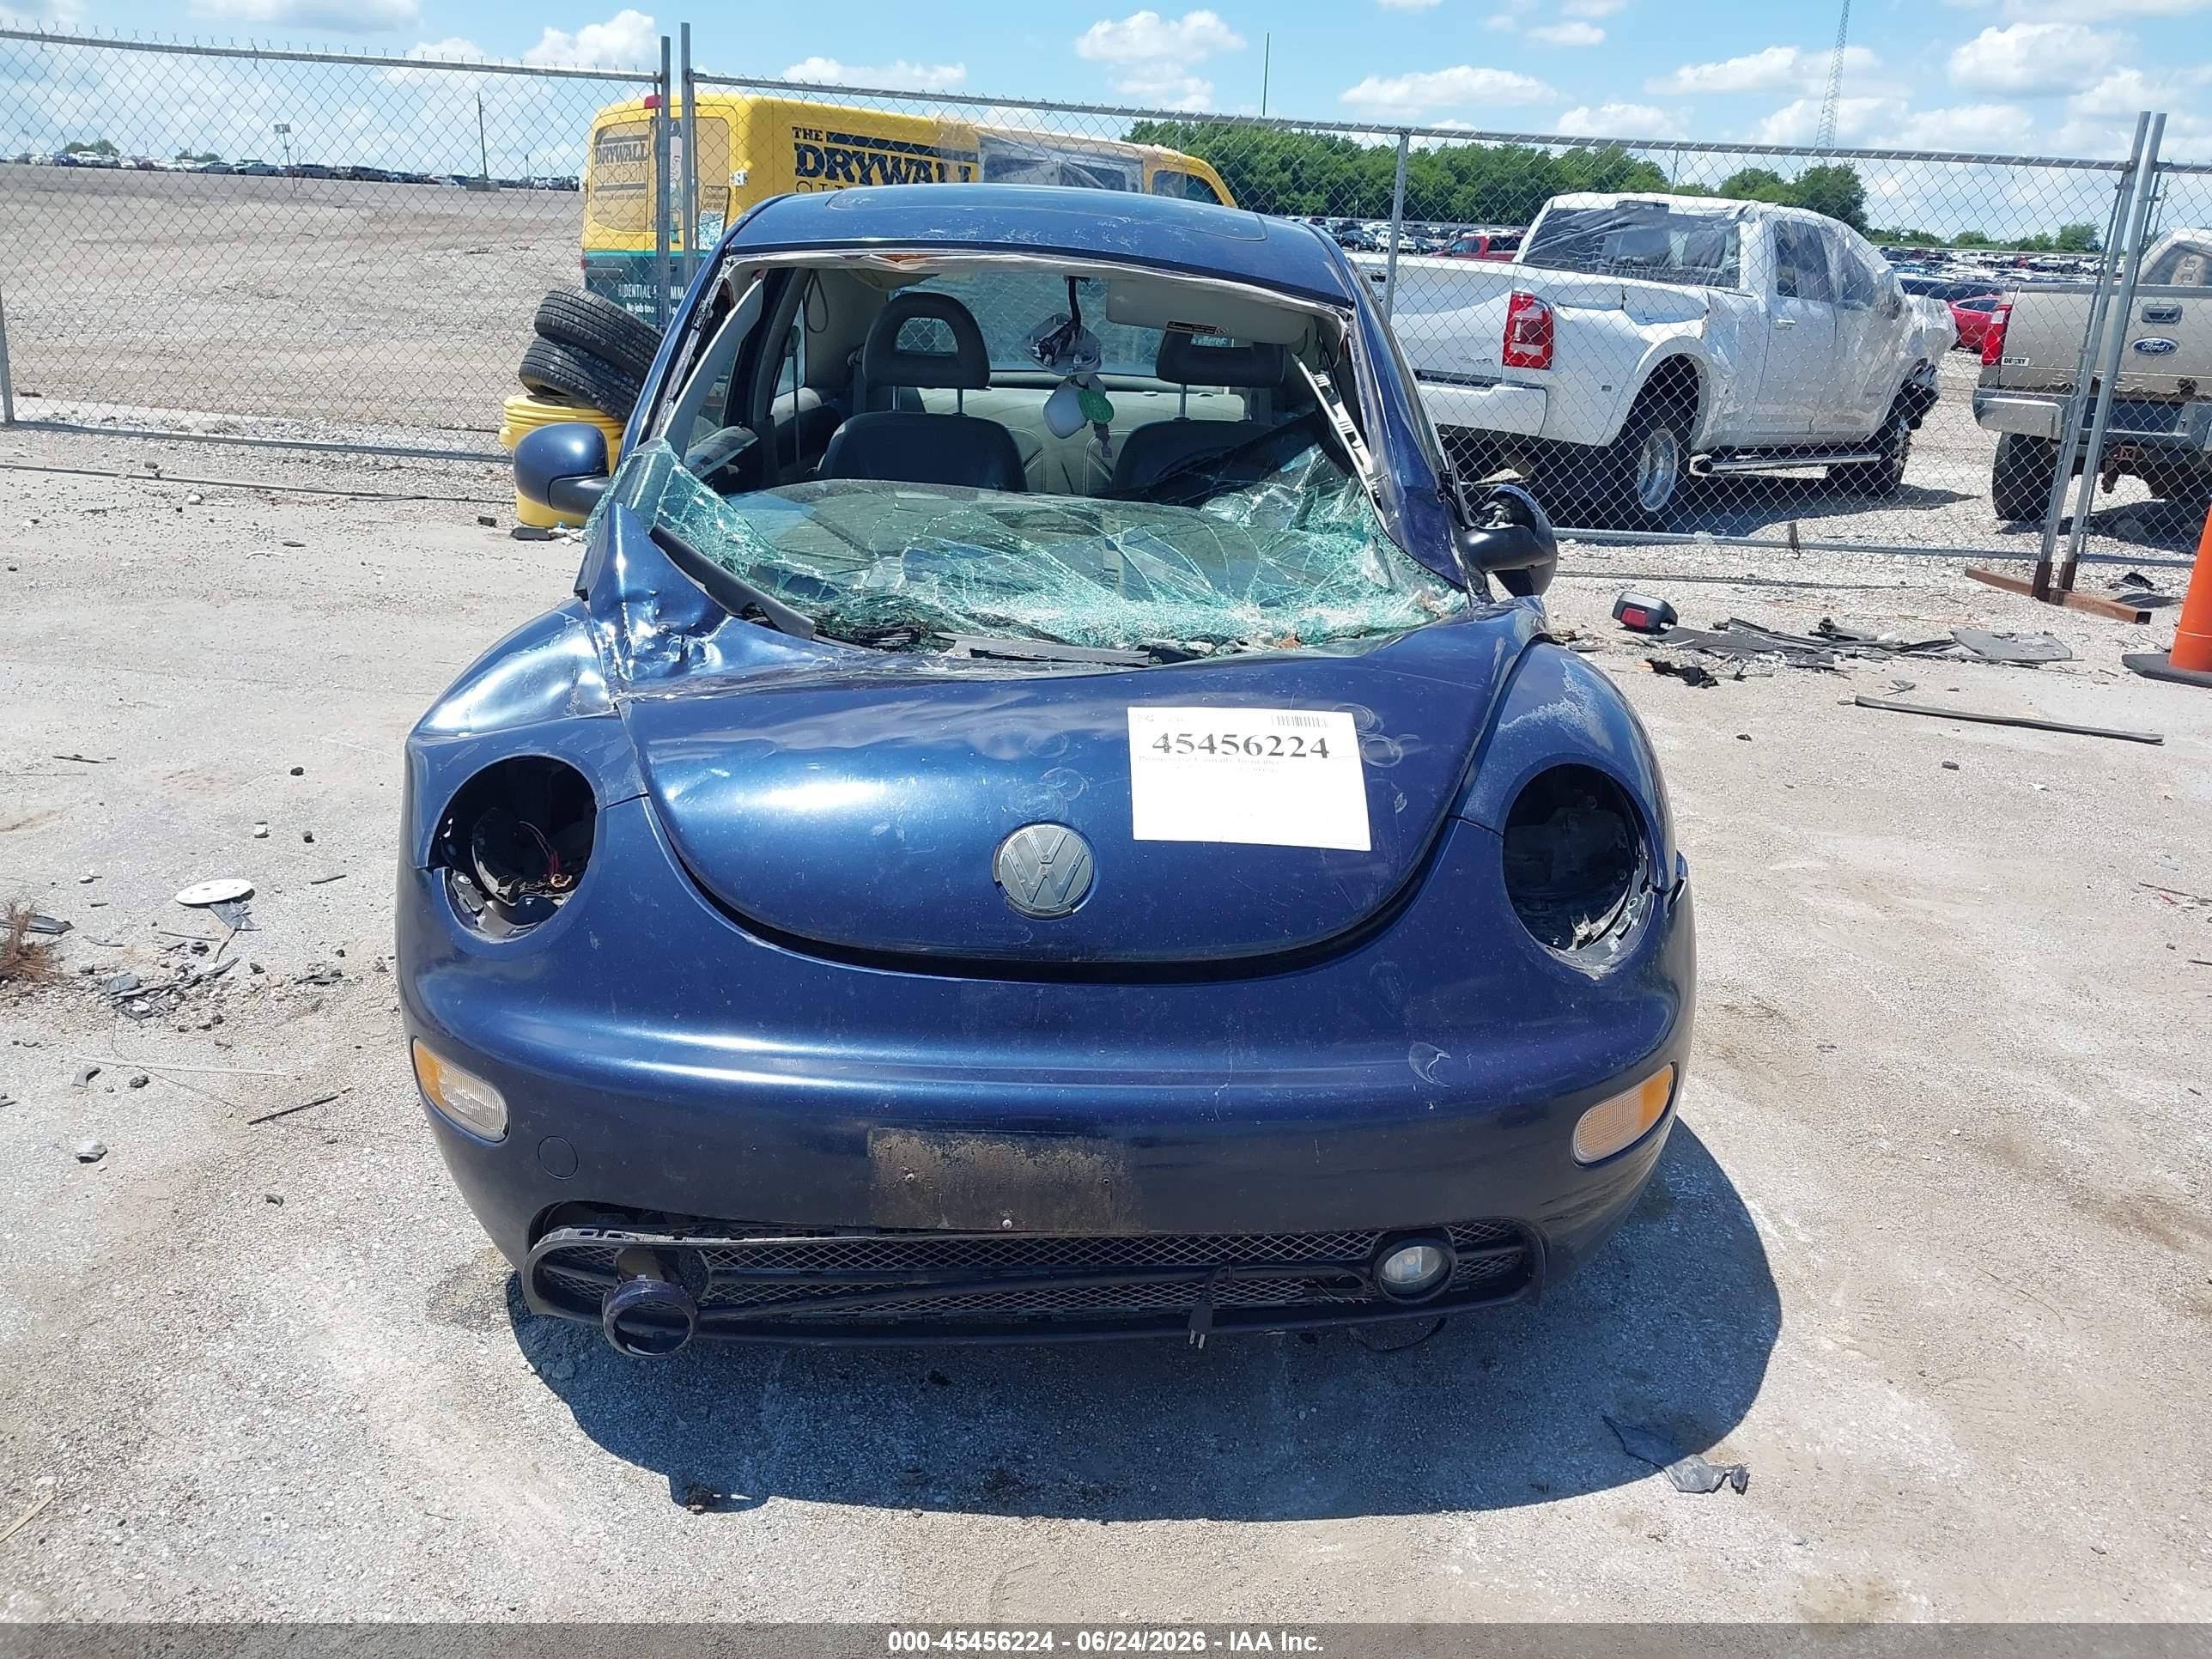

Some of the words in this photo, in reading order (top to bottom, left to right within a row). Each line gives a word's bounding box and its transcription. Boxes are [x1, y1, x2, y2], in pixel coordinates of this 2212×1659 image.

[792, 126, 823, 142] THE
[634, 303, 644, 314] job
[644, 305, 654, 313] too
[1152, 732, 1330, 759] 45456224
